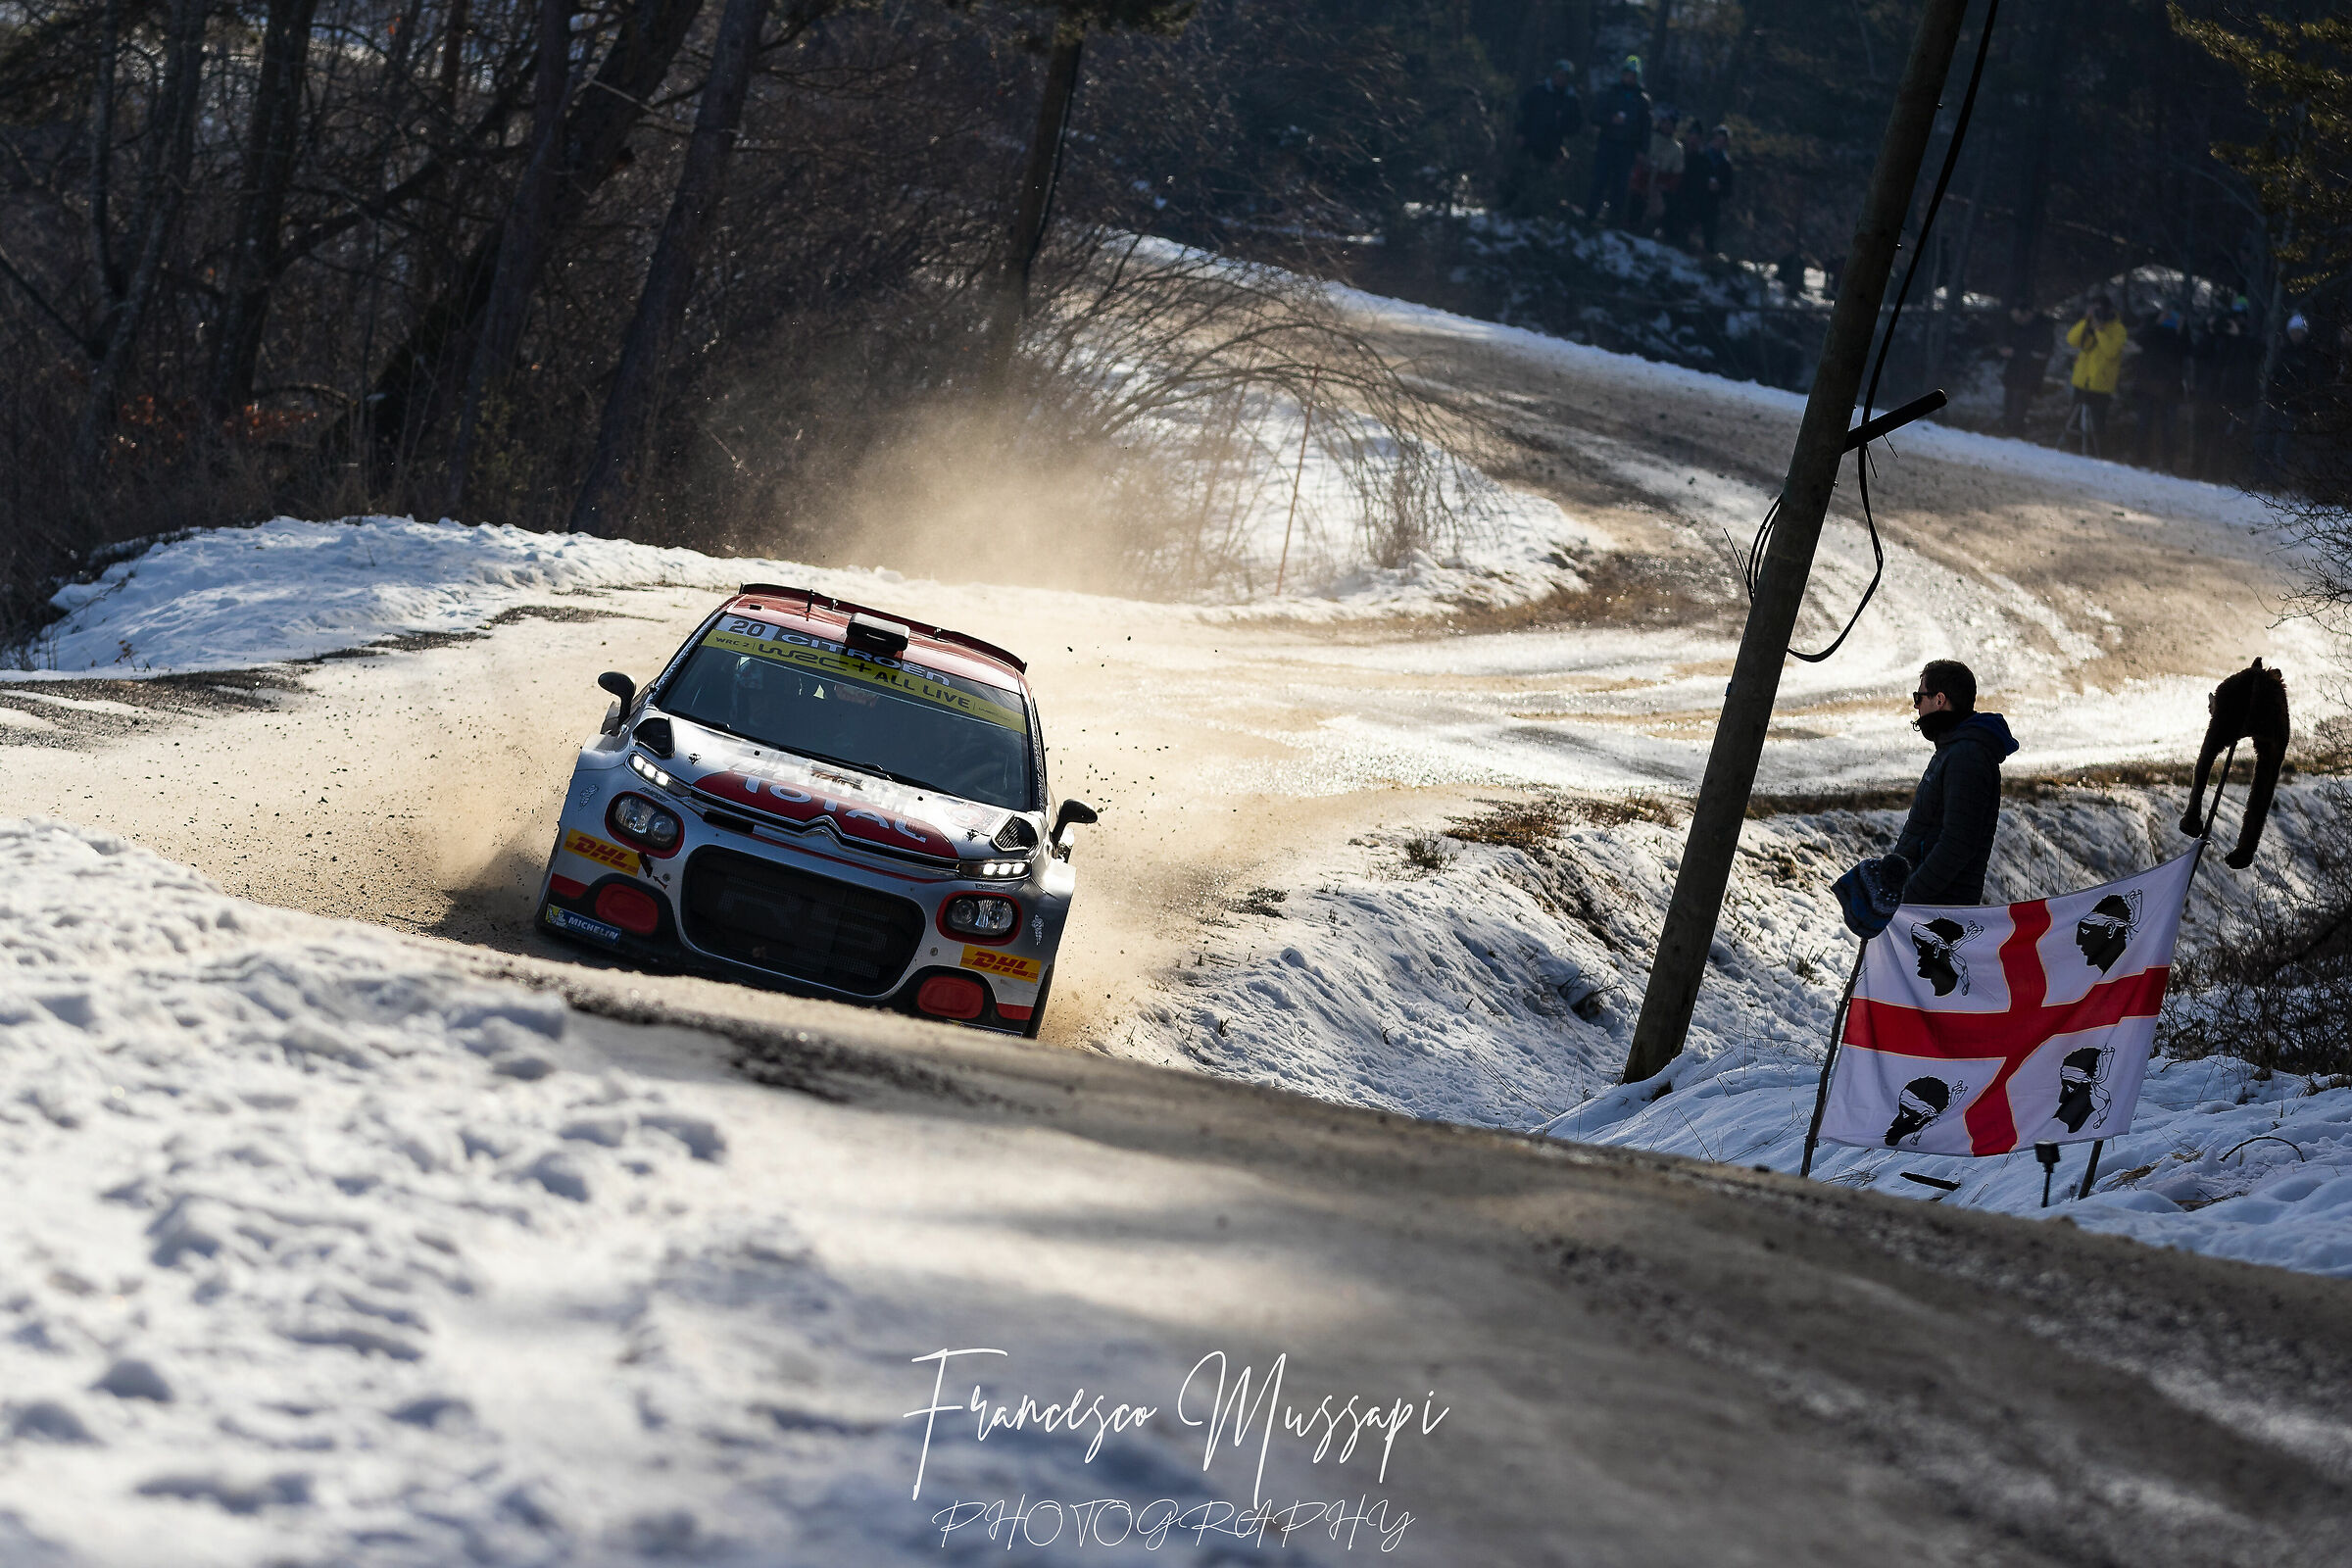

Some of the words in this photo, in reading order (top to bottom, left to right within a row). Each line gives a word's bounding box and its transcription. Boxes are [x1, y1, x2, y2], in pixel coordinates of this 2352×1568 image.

[728, 619, 765, 637] 20
[715, 636, 740, 647] WRC
[874, 671, 915, 691] ALL
[922, 684, 971, 710] LIVE
[733, 771, 927, 844] TOTAL
[573, 836, 628, 869] DHL
[568, 916, 619, 940] MICHELIN
[971, 952, 1029, 977] DHL
